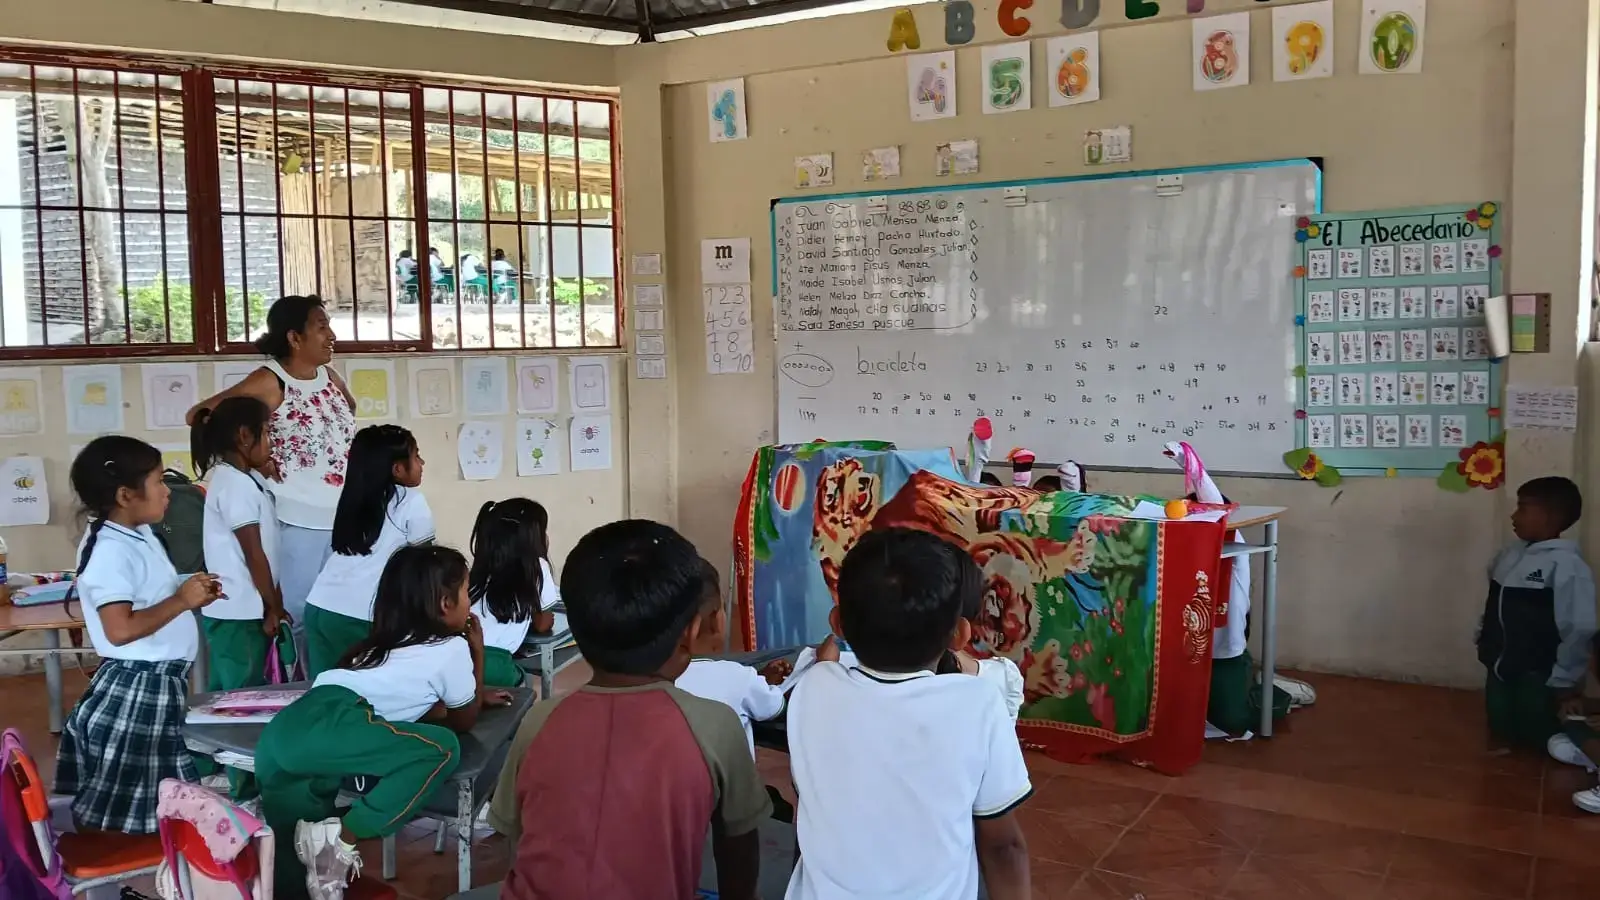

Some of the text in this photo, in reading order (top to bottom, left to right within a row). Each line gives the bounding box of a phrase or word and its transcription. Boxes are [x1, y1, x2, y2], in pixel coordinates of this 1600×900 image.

[887, 8, 921, 52] A
[945, 0, 976, 45] B
[1200, 30, 1239, 83] 8
[1286, 20, 1324, 75] 9
[1056, 46, 1091, 98] 6
[917, 66, 948, 114] 4
[989, 57, 1025, 110] 5
[796, 220, 826, 235] Juan
[1322, 213, 1474, 246] El Abecedario
[714, 244, 734, 260] m
[798, 248, 827, 260] David
[832, 246, 881, 262] Santiago
[889, 243, 937, 256] Gonzales
[832, 274, 867, 287] Isabel
[704, 285, 746, 306] 1 2 3
[706, 310, 748, 331] 4 5 6
[1153, 304, 1168, 315] 32
[706, 331, 740, 353] 7 8
[712, 352, 722, 375] 9
[857, 346, 927, 375] bicicleta
[873, 392, 882, 400] 20
[920, 392, 932, 401] 50
[1044, 393, 1056, 403] 40
